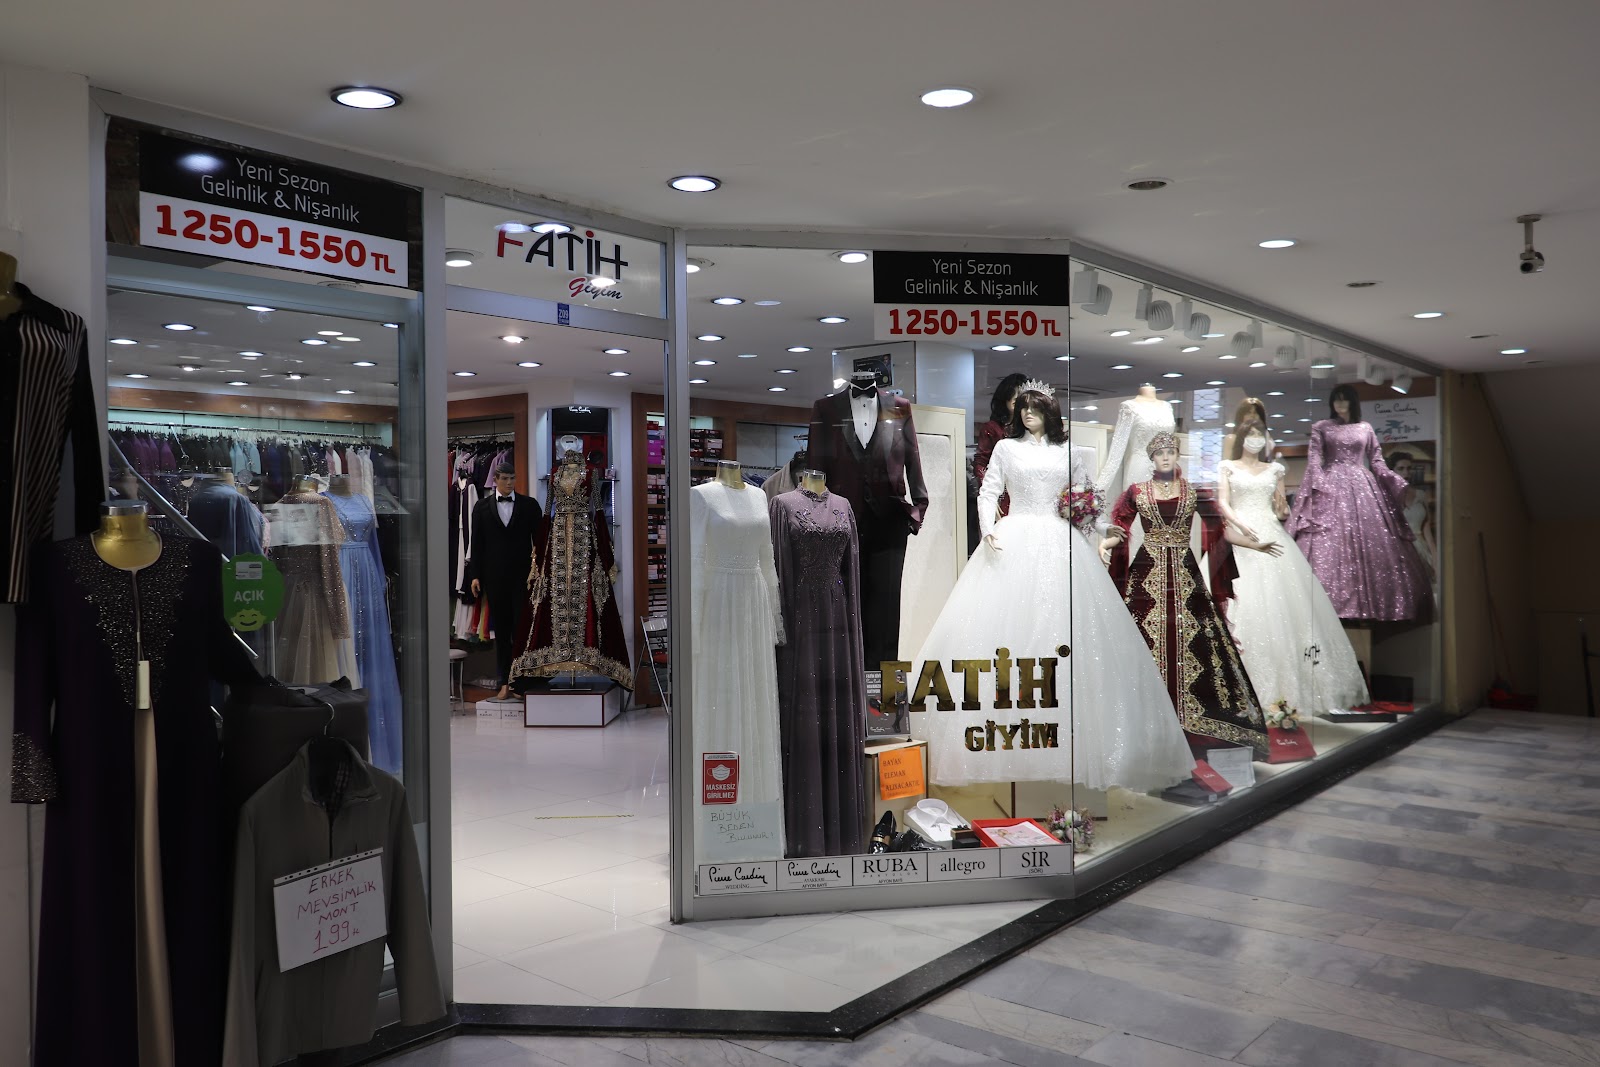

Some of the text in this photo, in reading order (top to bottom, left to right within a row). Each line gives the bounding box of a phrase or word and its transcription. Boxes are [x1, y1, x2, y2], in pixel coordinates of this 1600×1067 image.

[236, 157, 330, 196] Yeni Sezon
[201, 174, 360, 224] Gelinlik & Nişanlık
[932, 258, 1012, 276] Yeni Sezon
[905, 278, 1039, 299] Gelinlik & Nişanlık
[234, 590, 265, 605] AÇIK
[879, 647, 1059, 713] FATİH
[964, 718, 1059, 752] GİYİM
[706, 782, 736, 791] MASKESİZ
[707, 790, 735, 799] GİRİLMEZ
[717, 821, 755, 834] BEDEN
[863, 857, 918, 874] RUBA
[940, 857, 986, 875] allegro
[1021, 847, 1051, 868] SİR
[308, 866, 355, 895] ERKEK
[734, 866, 768, 884] Cardin
[810, 861, 841, 879] Cardin
[297, 880, 377, 920] MEVSİMLİK
[318, 901, 359, 925] MONT
[312, 920, 350, 954] 199
